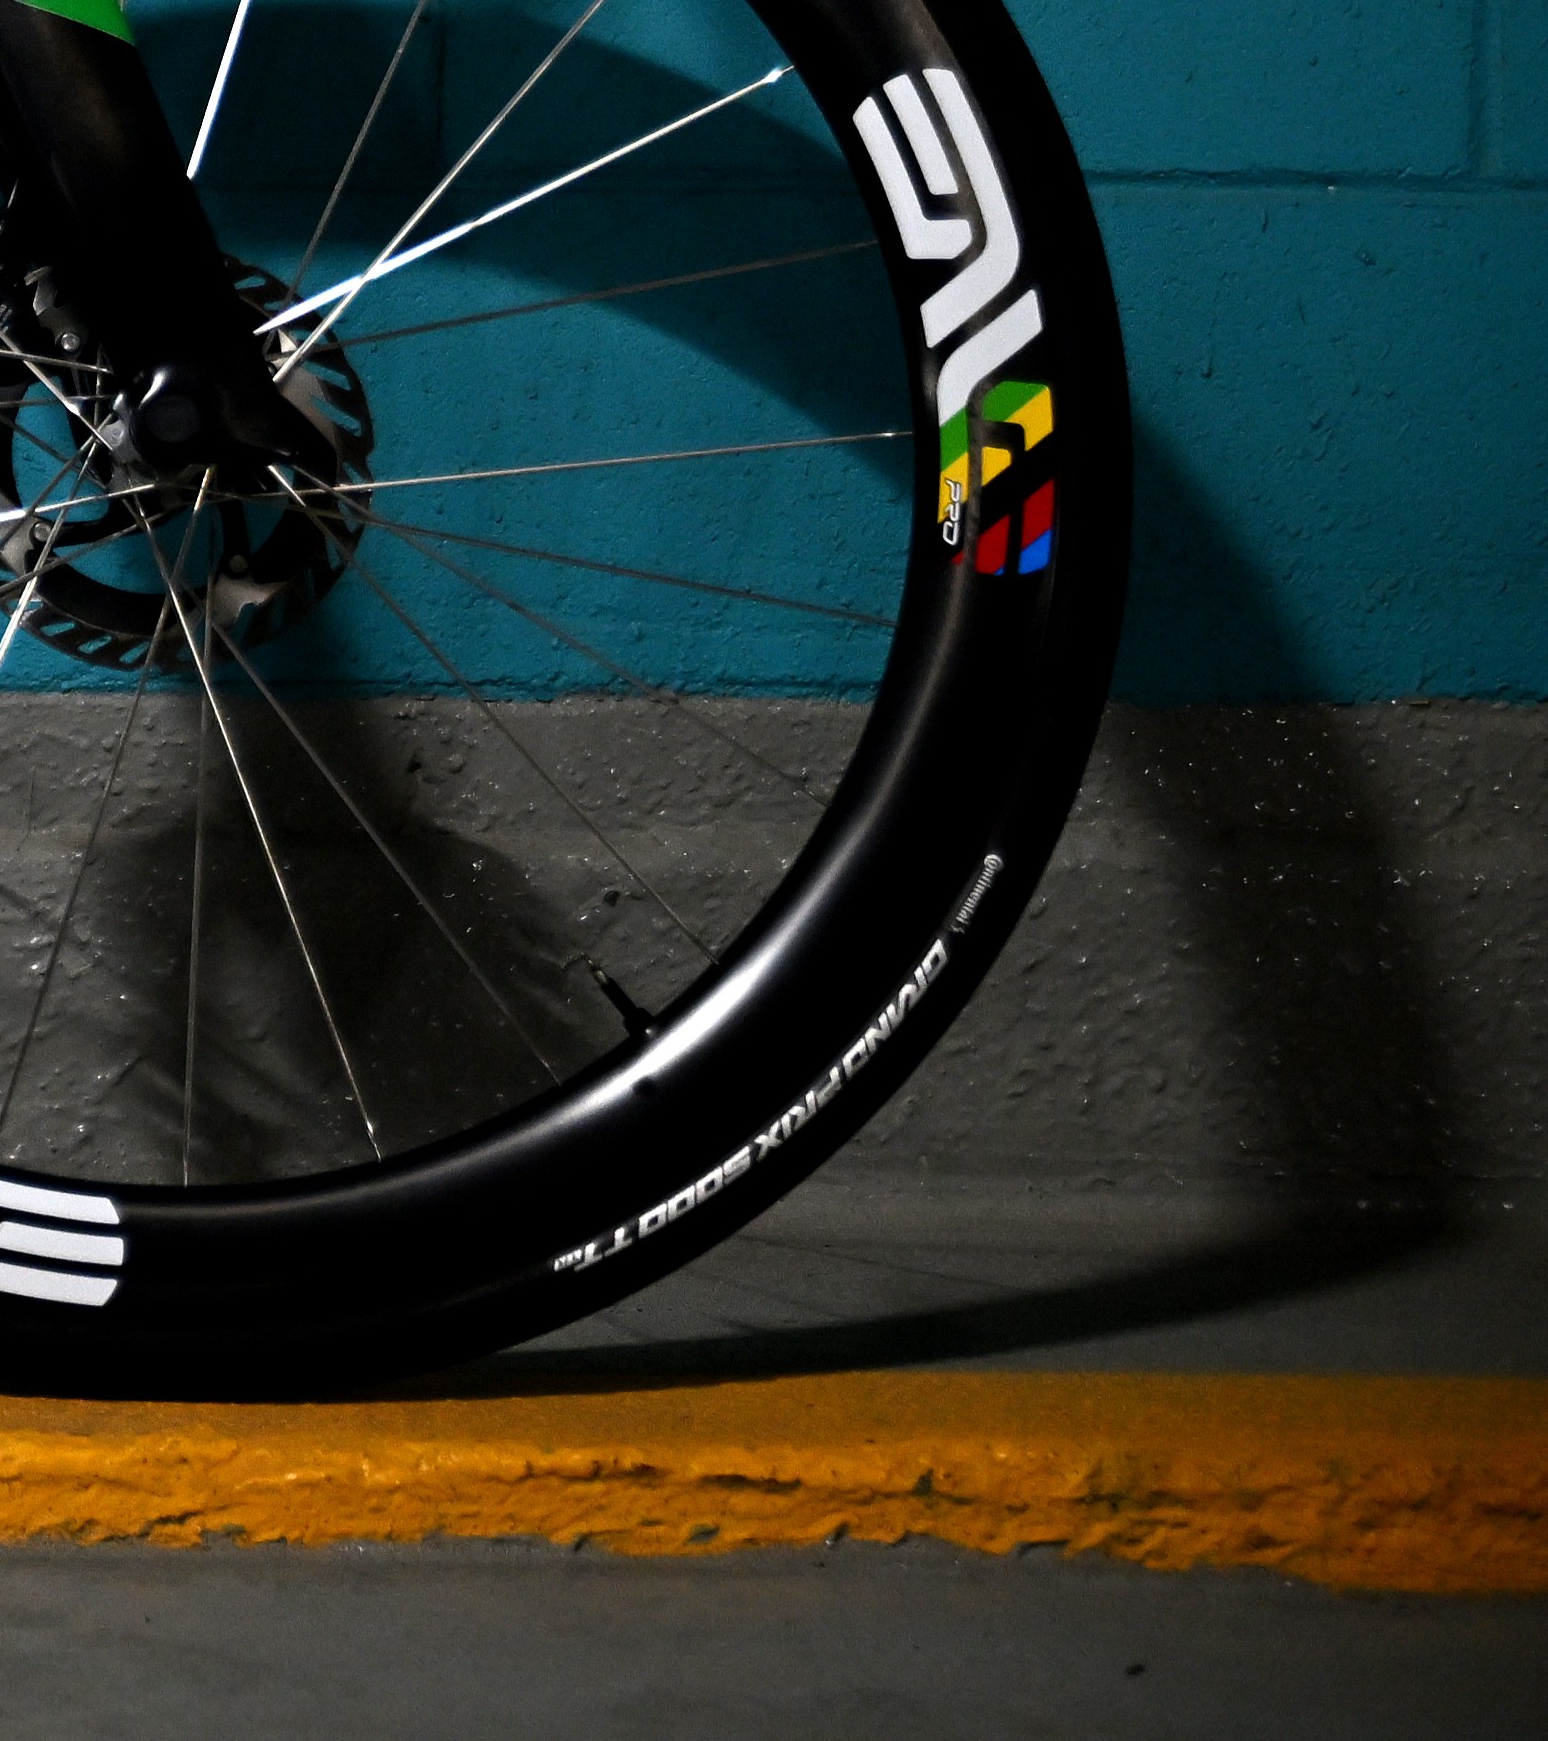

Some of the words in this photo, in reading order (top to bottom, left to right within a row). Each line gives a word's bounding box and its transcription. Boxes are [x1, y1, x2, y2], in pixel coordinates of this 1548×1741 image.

[943, 479, 962, 546] PRO
[842, 938, 948, 1081] GRAND
[754, 1066, 843, 1162] PRIX
[638, 1145, 750, 1239] 5000
